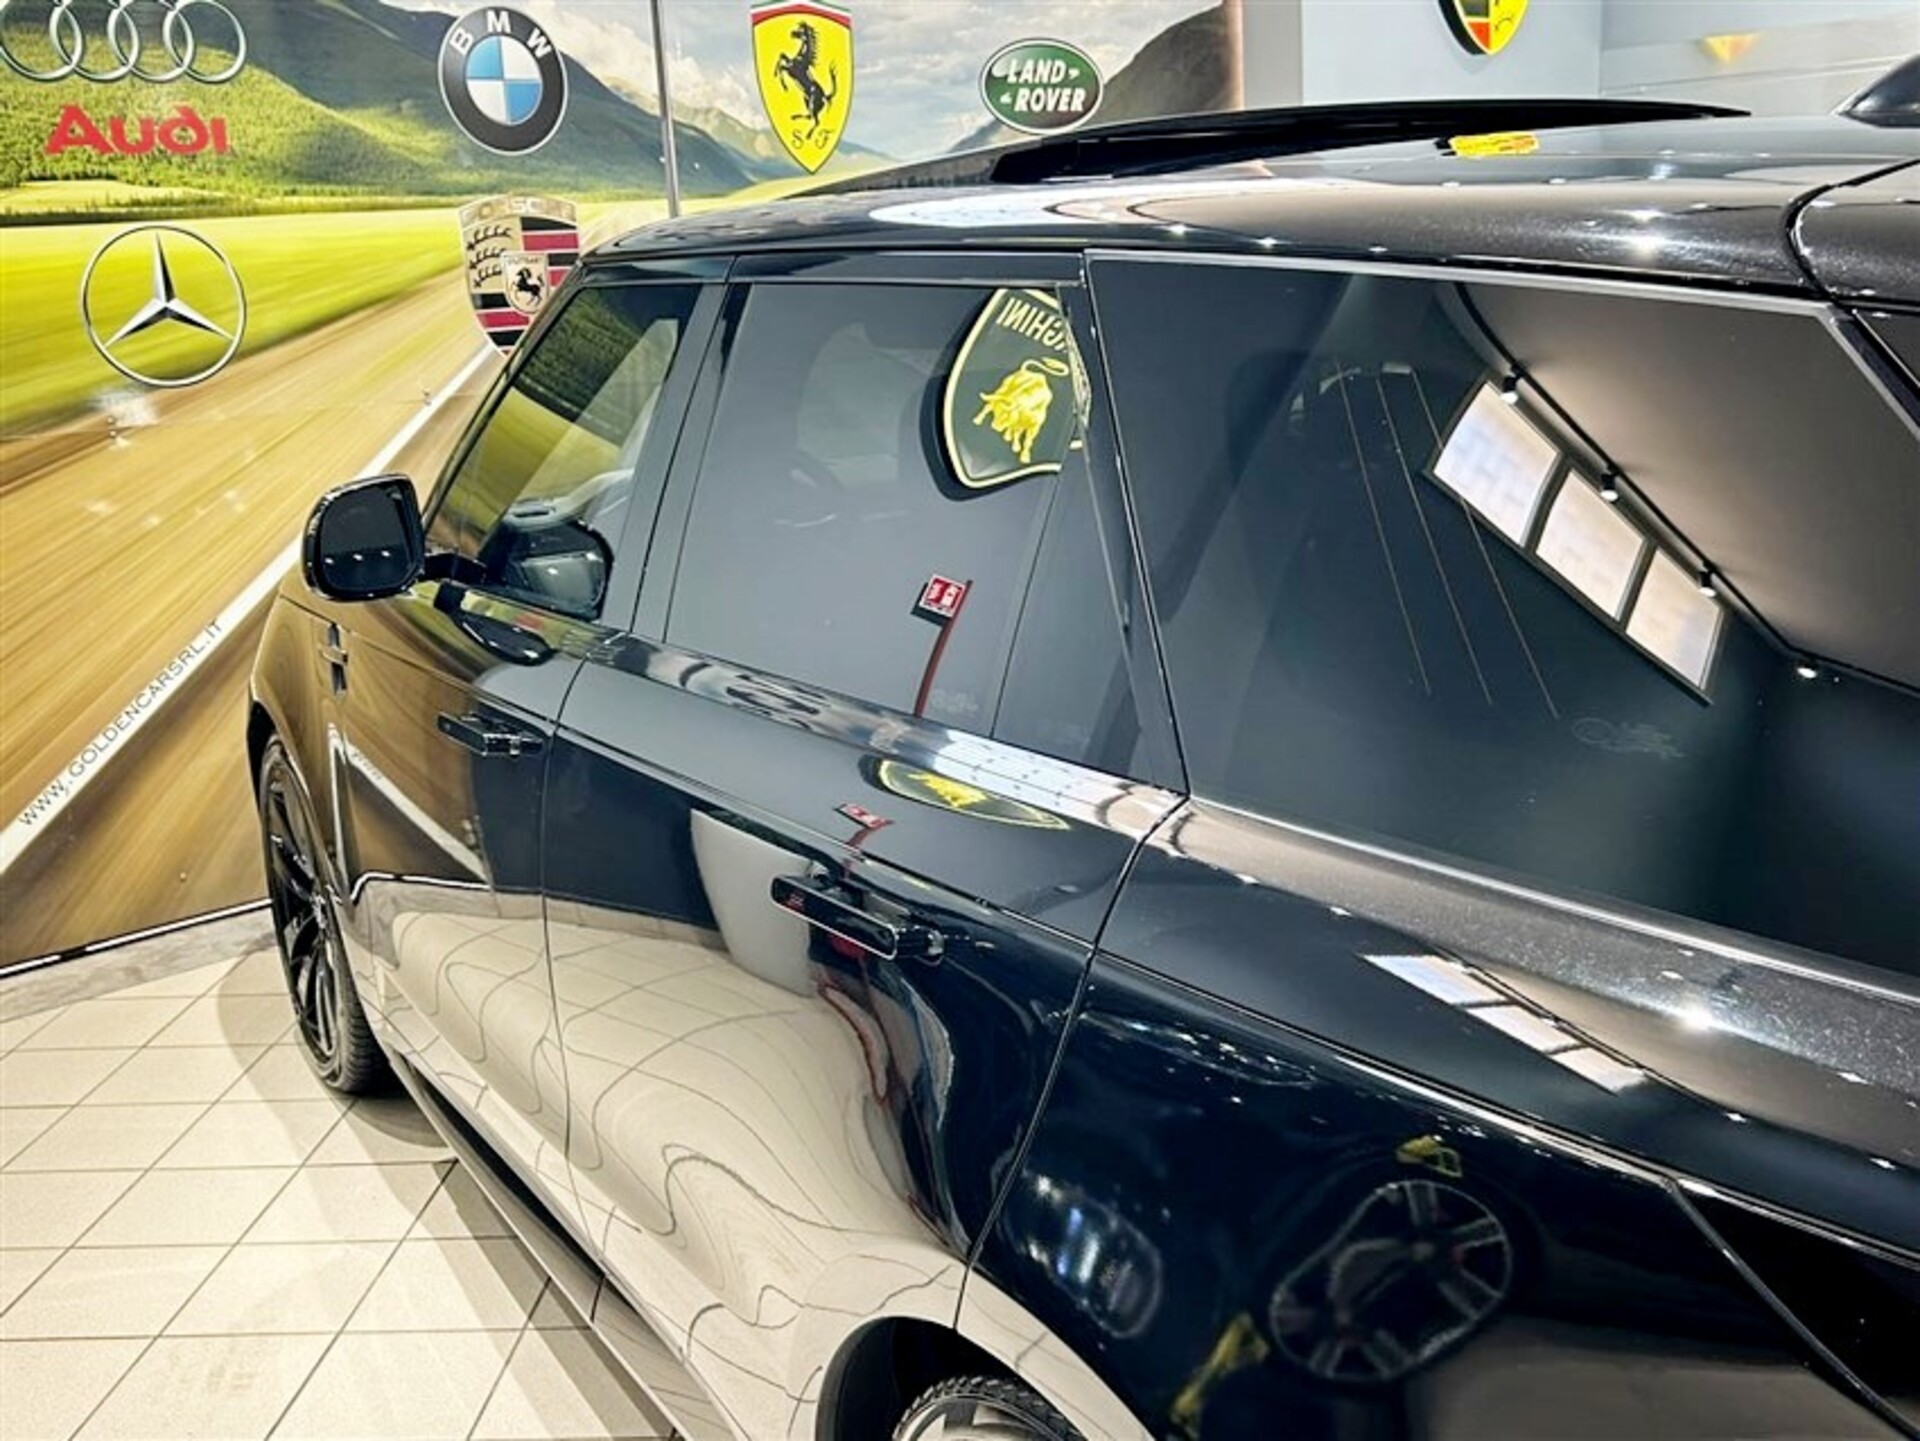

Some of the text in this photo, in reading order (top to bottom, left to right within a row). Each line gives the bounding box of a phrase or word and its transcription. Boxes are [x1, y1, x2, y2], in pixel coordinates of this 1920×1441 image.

[449, 10, 553, 59] BMW
[1006, 58, 1067, 84] LAND
[1014, 87, 1086, 112] ROVER
[461, 196, 577, 224] PORSC
[19, 617, 223, 826] WWW.GOLDENCARSRL.IT
